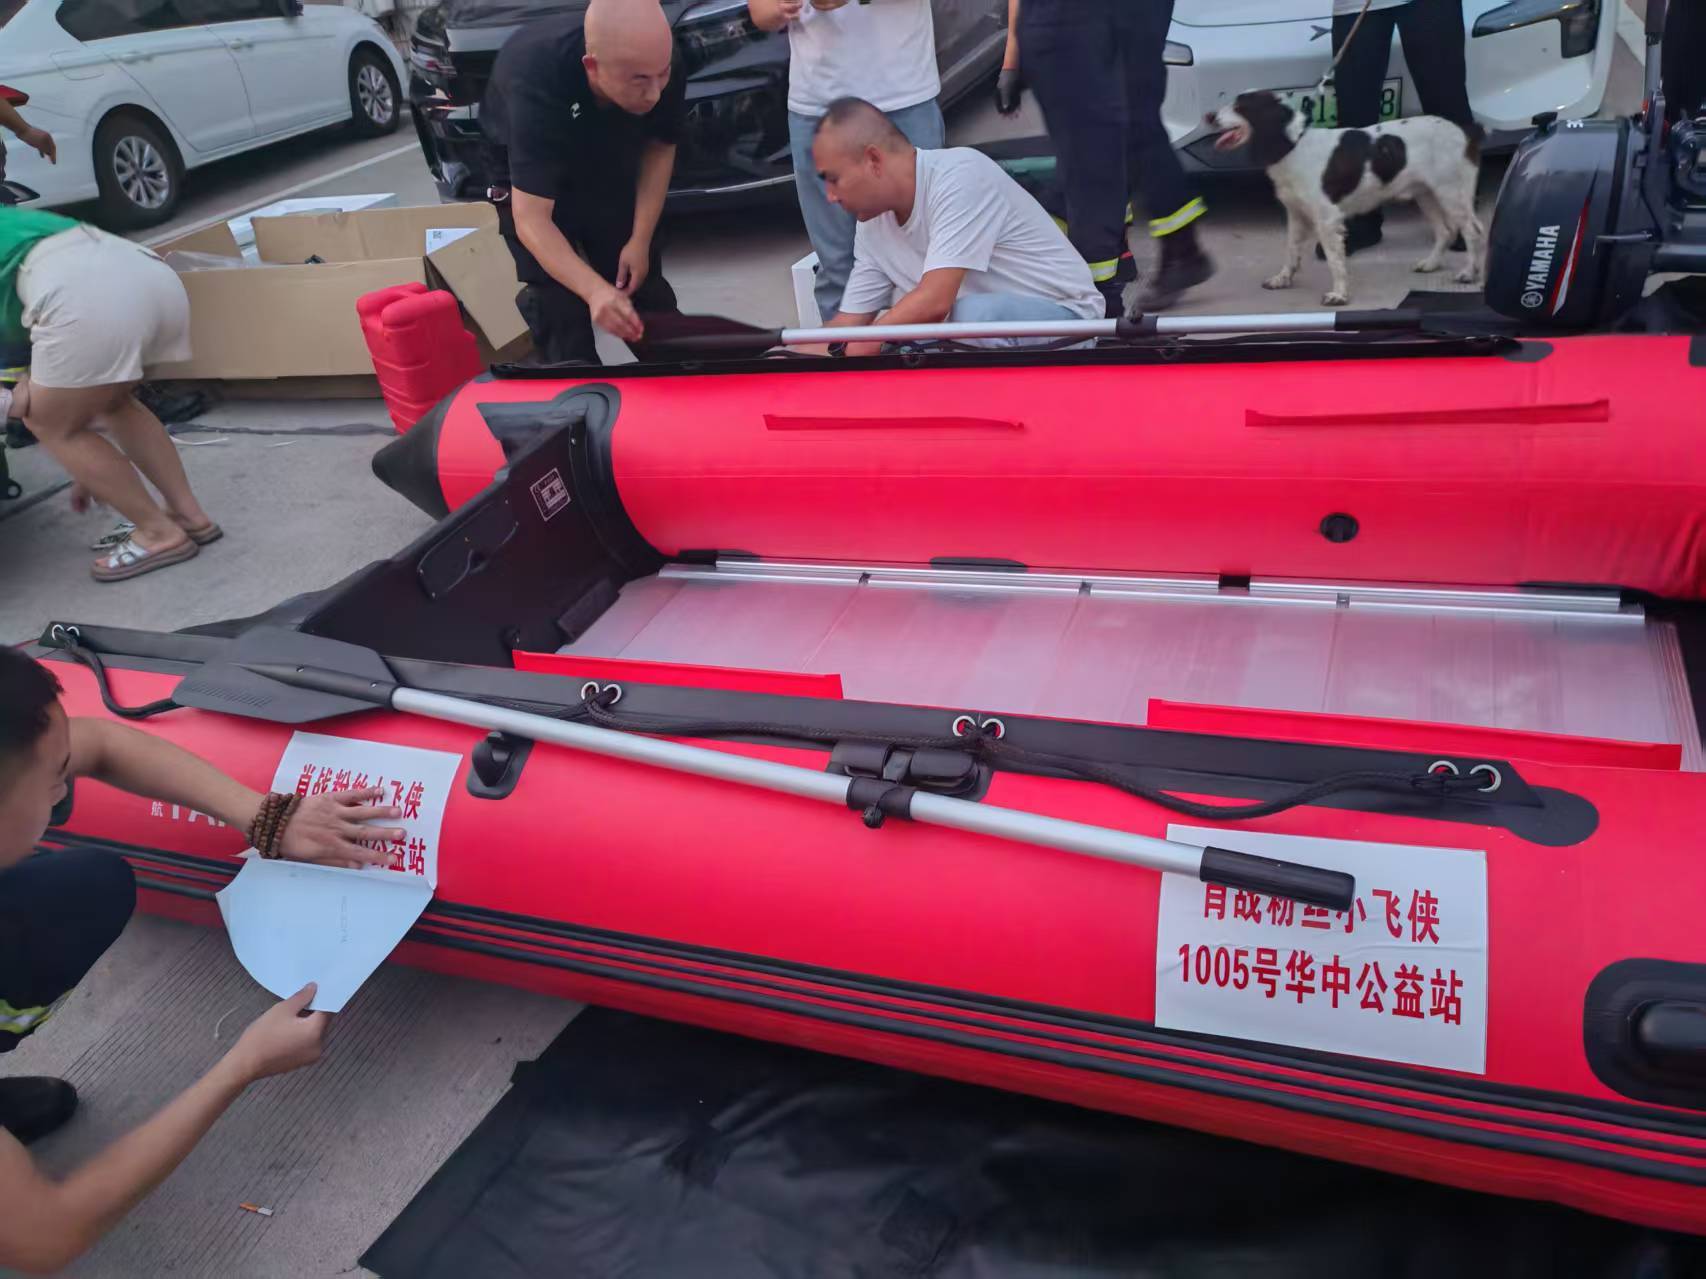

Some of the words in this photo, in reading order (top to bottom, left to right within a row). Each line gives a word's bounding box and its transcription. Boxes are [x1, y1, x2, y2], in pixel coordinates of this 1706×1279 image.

[1524, 225, 1561, 291] YAMAHA
[1178, 943, 1464, 1026] 1005号华中公益站
